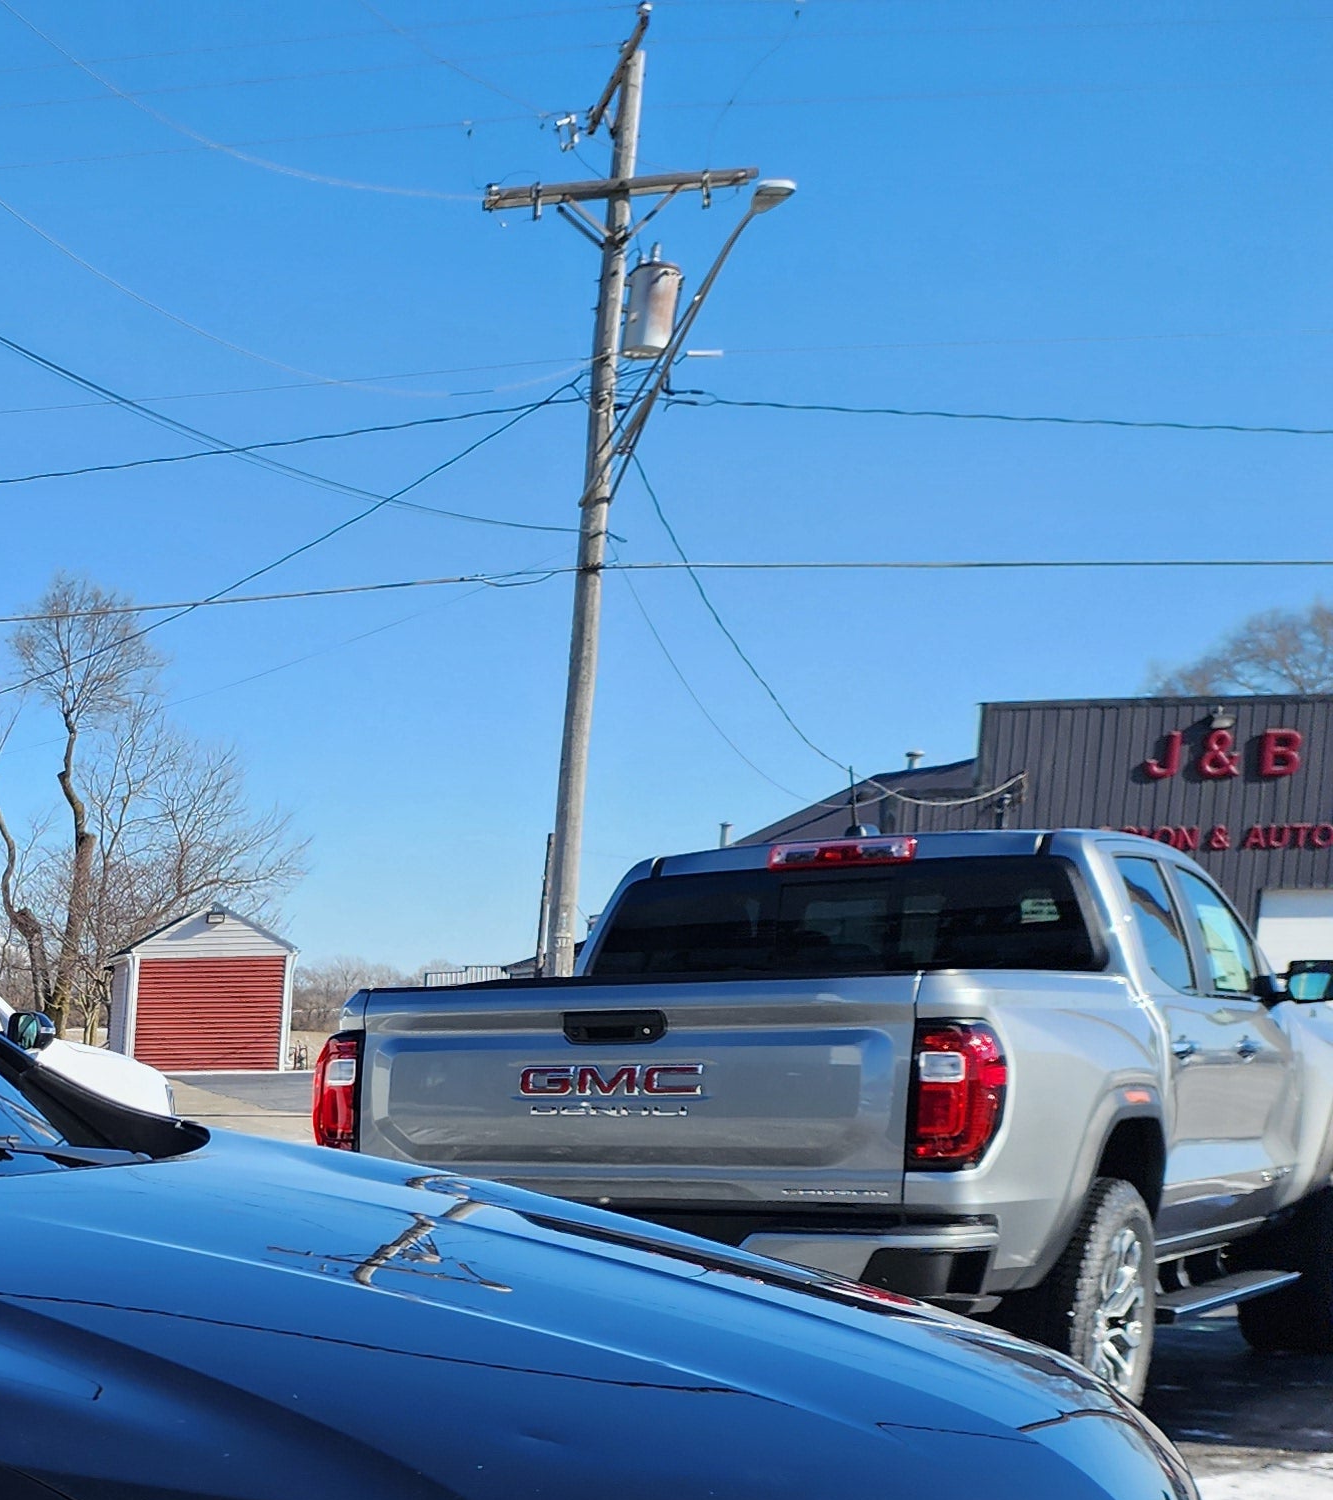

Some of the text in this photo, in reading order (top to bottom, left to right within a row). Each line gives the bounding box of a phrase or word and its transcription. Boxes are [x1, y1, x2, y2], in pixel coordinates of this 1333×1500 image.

[1144, 727, 1302, 778] J & B
[1210, 824, 1230, 849] &
[1244, 823, 1333, 850] AUTO
[520, 1064, 703, 1097] GMC
